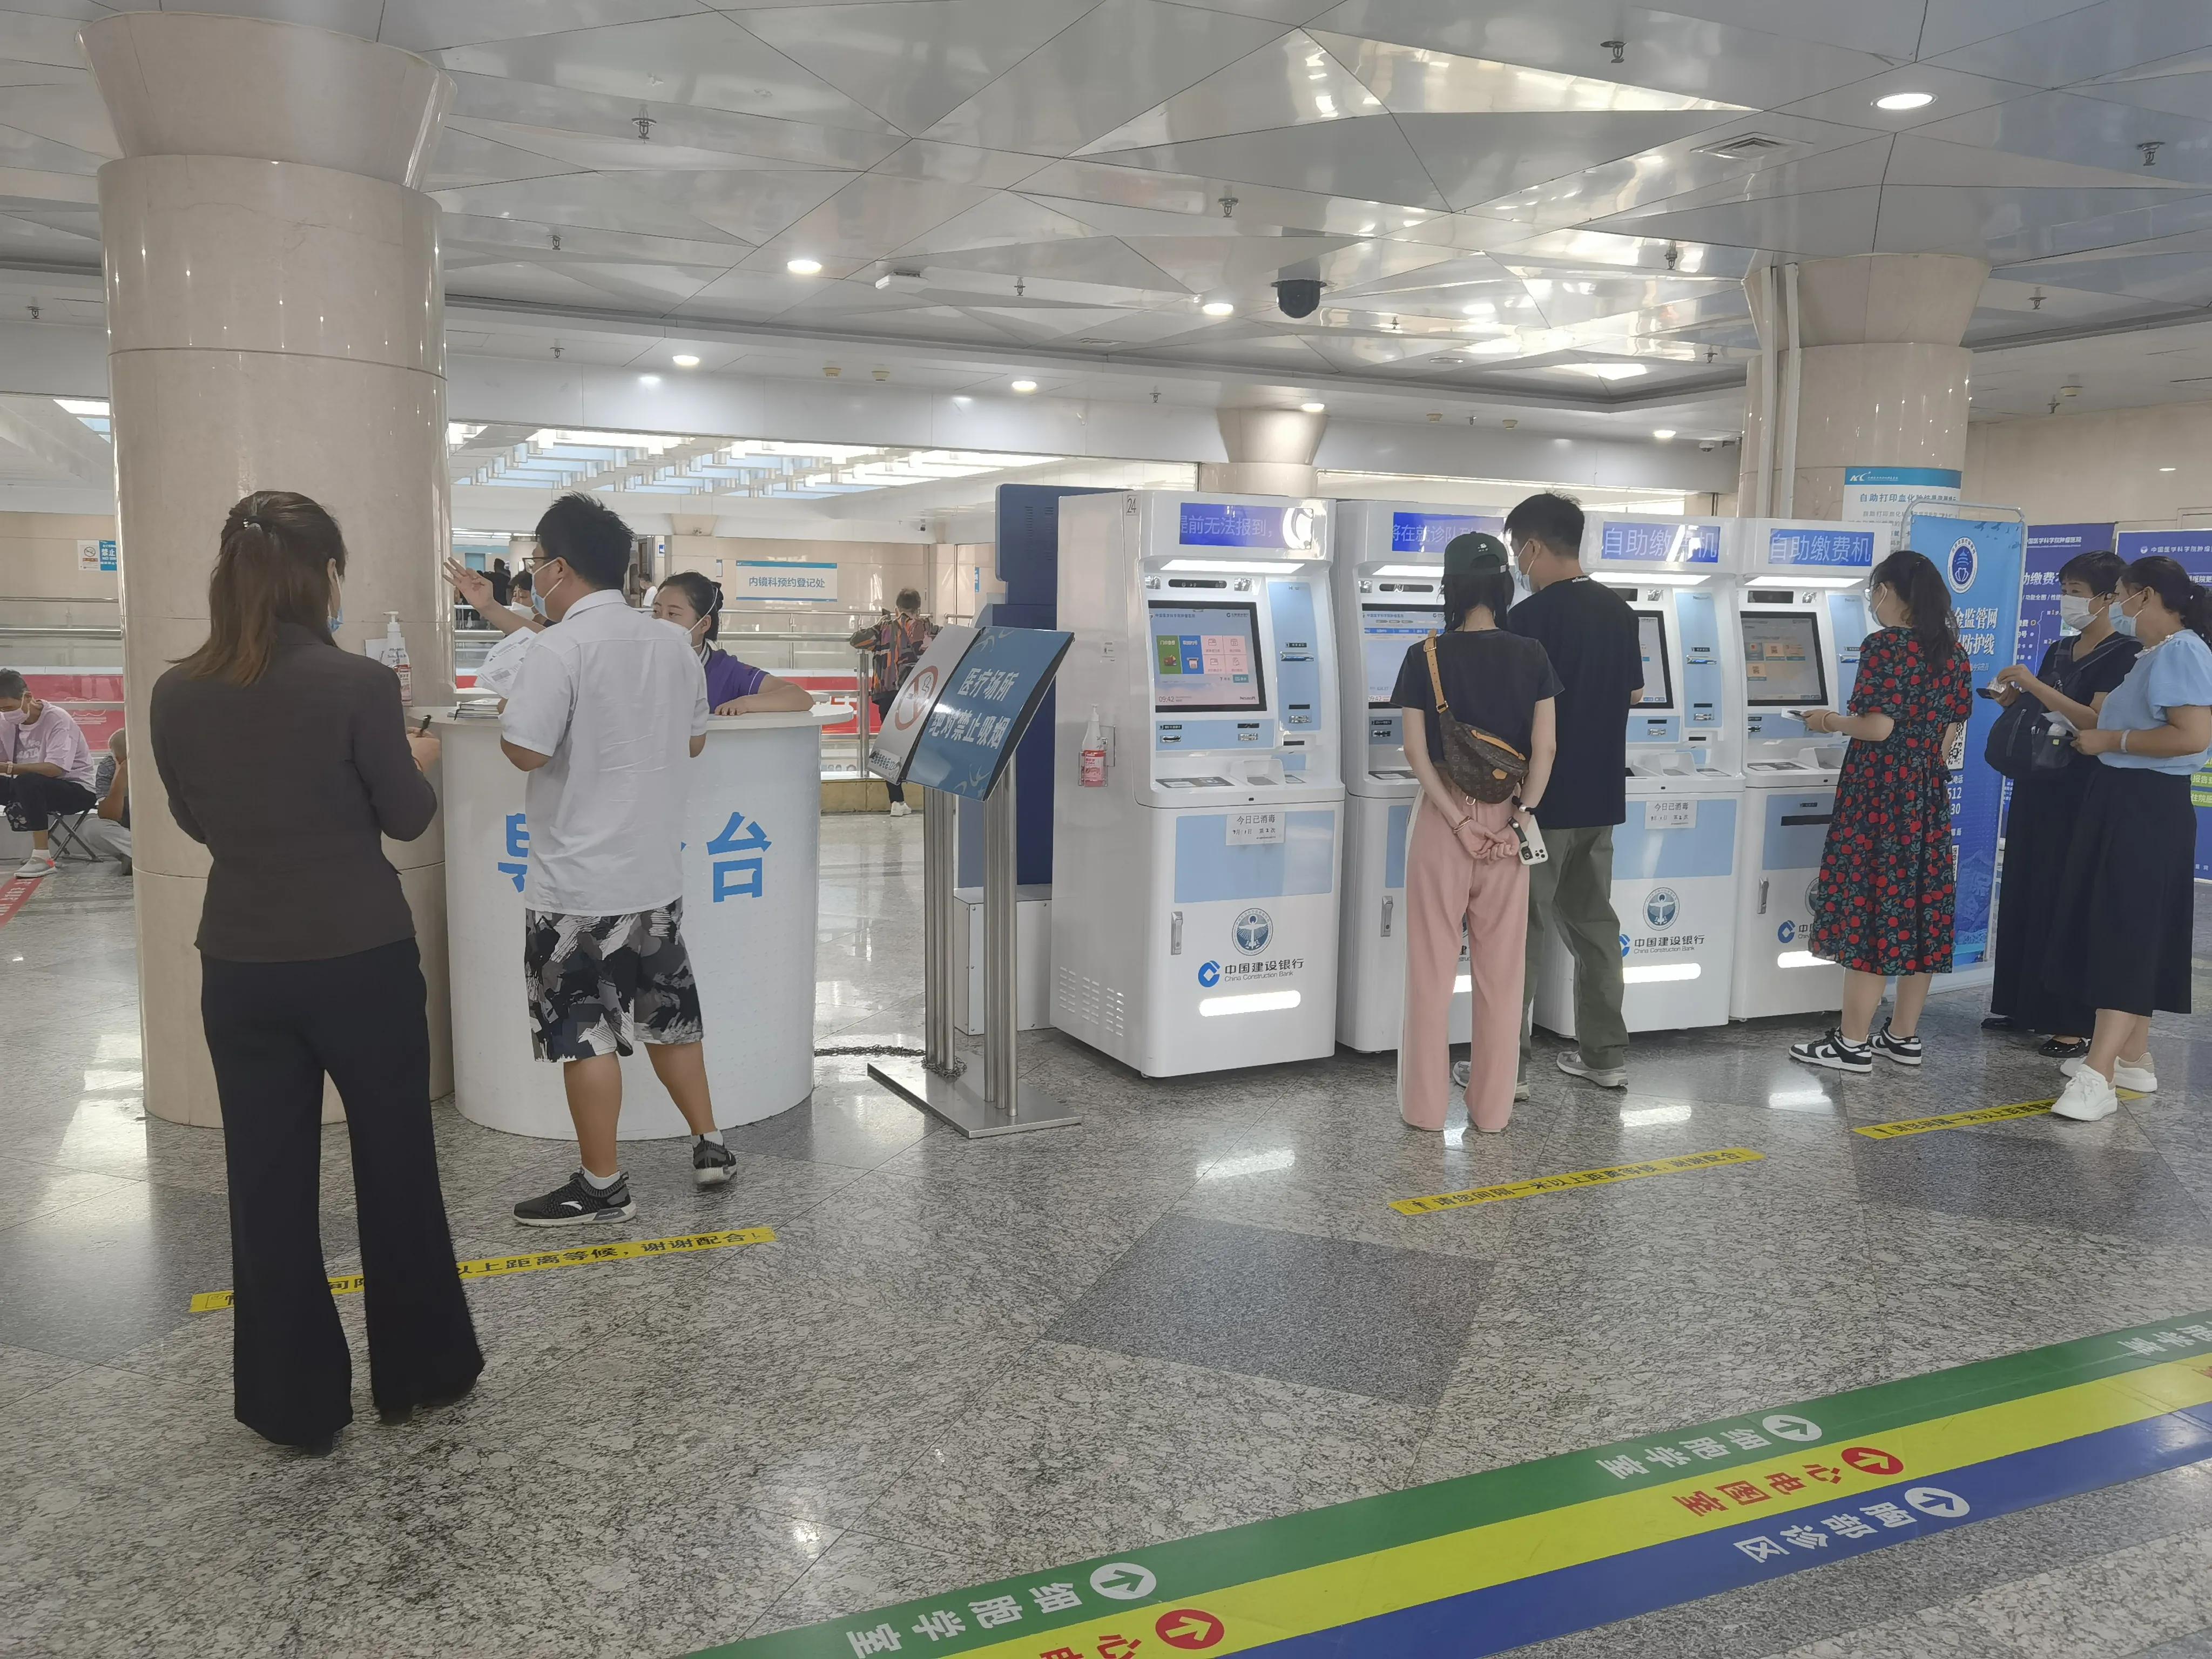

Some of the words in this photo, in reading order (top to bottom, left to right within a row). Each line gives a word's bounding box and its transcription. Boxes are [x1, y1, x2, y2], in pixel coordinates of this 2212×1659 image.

[1127, 498, 1136, 513] 24
[1605, 528, 1717, 558] 自助缴机
[1771, 534, 1871, 562] 自助缴费机
[749, 576, 825, 588] 内镜科预约登记处
[1958, 633, 1995, 655] 防护线
[957, 667, 1019, 701] 医疗场所
[929, 709, 1011, 749] 绝对禁止吸烟
[1237, 814, 1276, 825] 今日已消毒
[1634, 935, 1705, 947] 中国建设银行
[1225, 958, 1304, 974] 中国建设银行
[1596, 1428, 1772, 1480] 细胞学室
[1671, 1464, 1842, 1517] 心电图室
[1734, 1502, 1918, 1563] 胸部诊区
[846, 1582, 1083, 1659] 细胞学室
